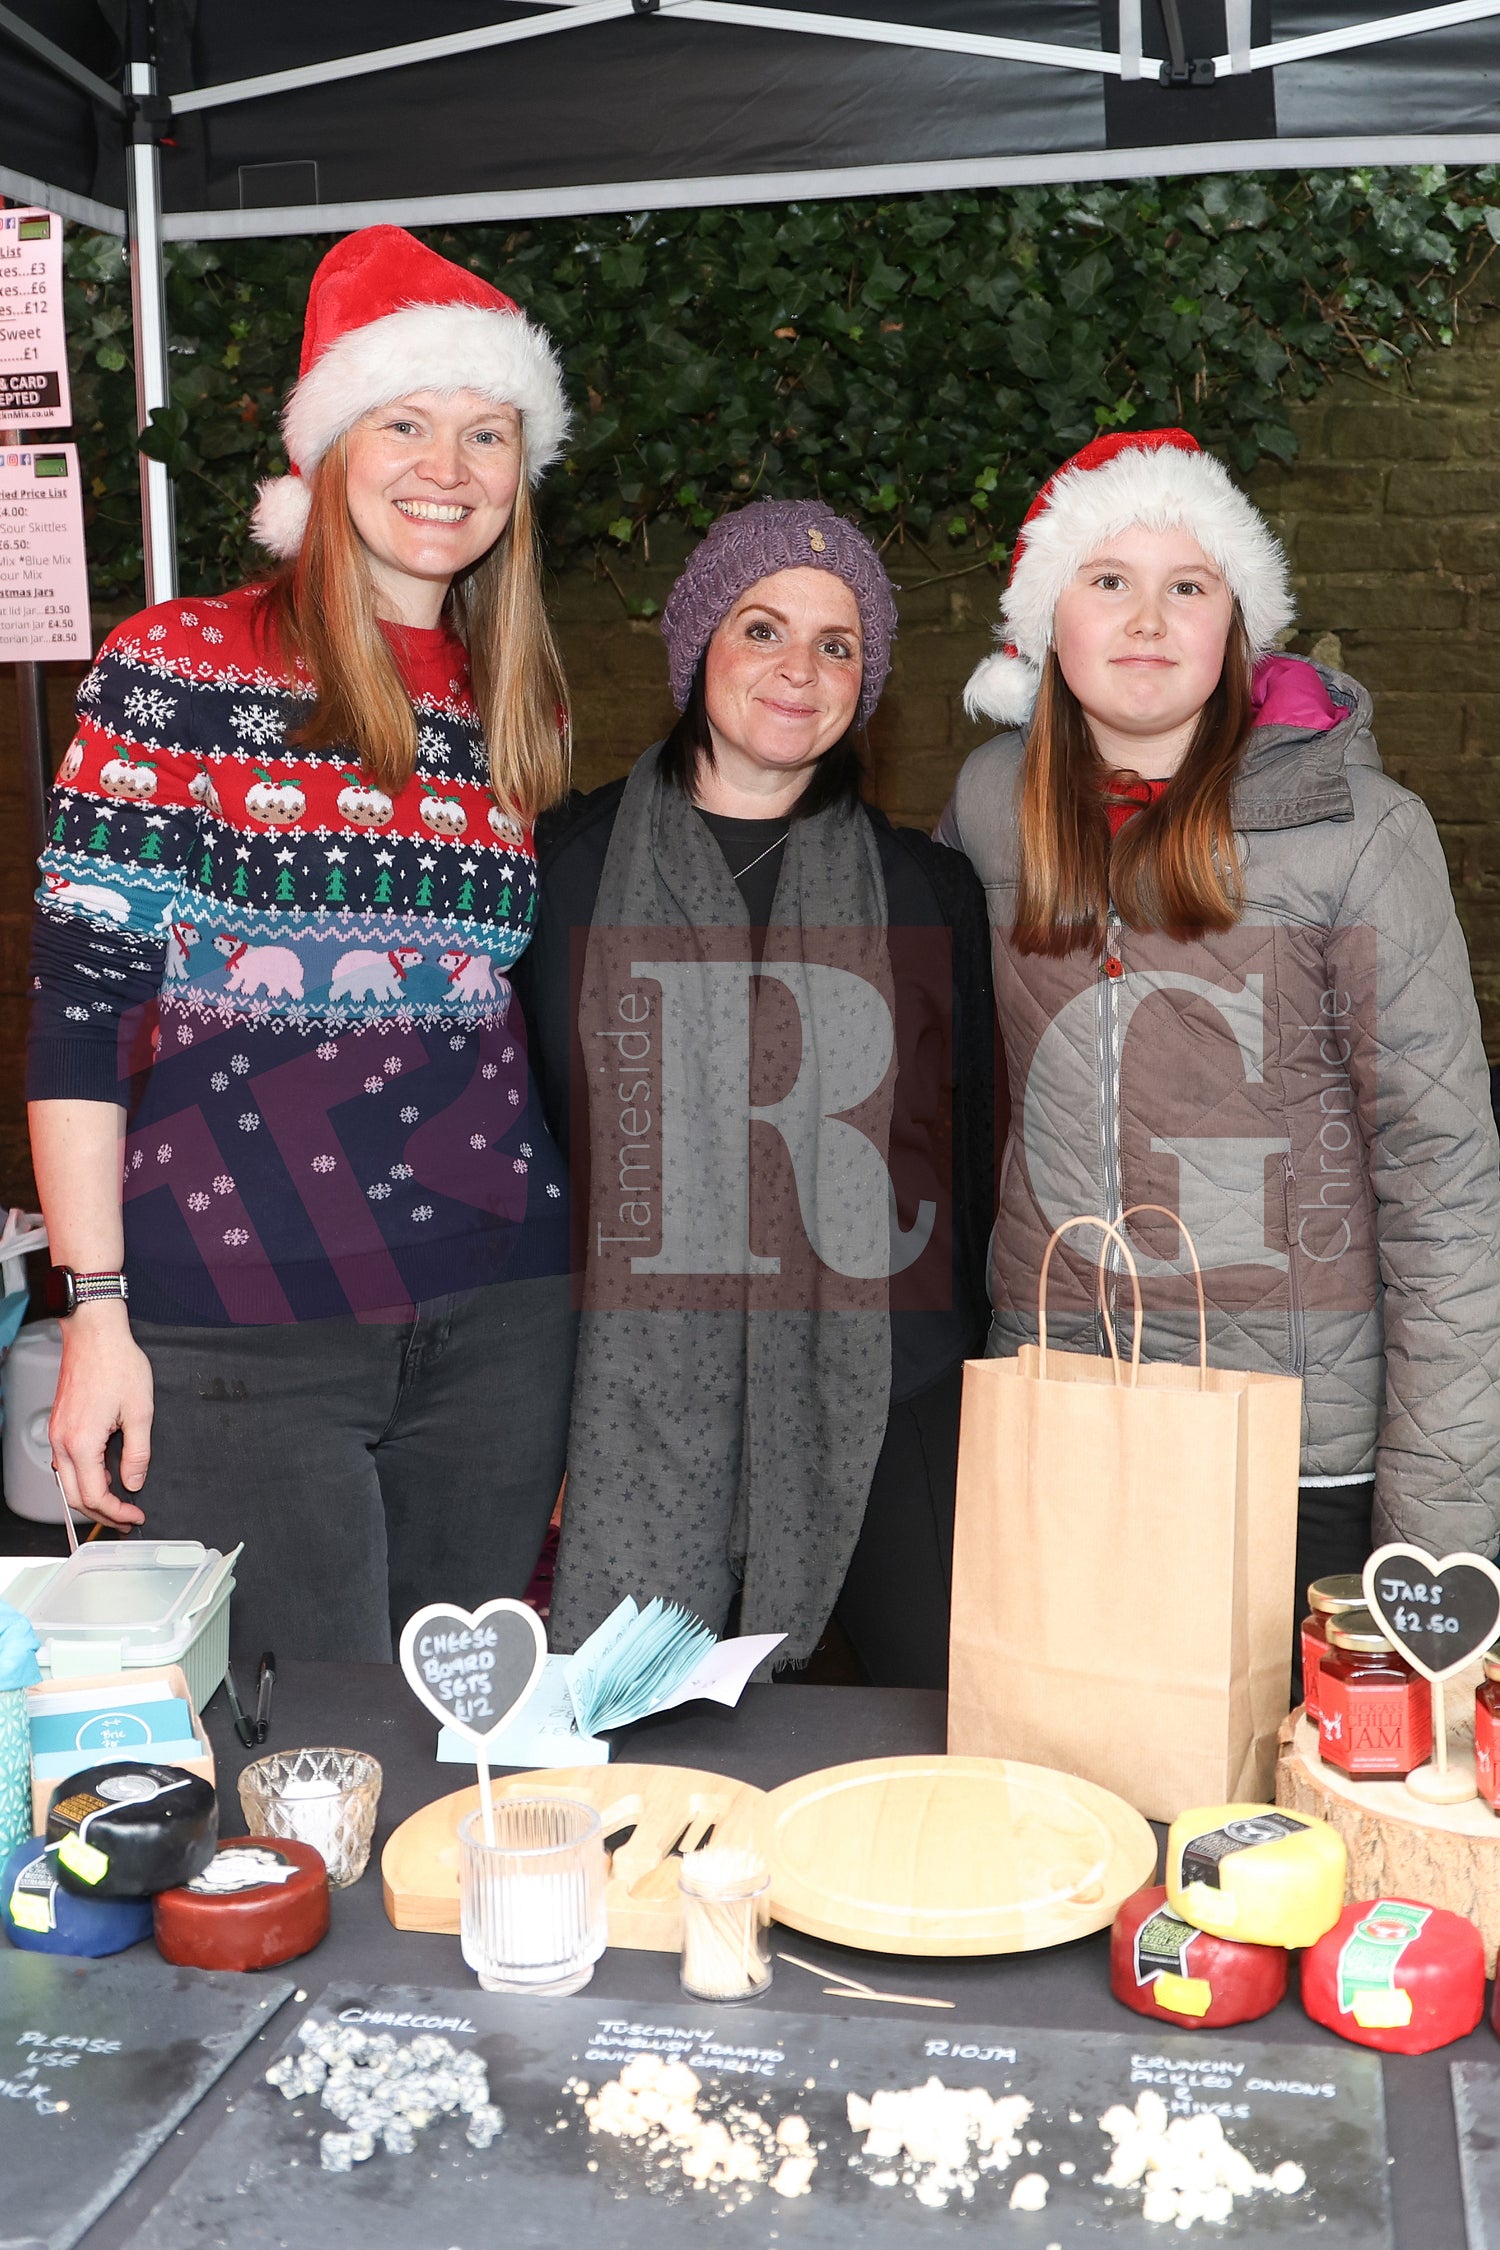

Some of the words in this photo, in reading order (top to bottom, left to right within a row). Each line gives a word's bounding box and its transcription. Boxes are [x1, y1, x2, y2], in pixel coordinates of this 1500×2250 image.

[0, 247, 21, 258] List
[0, 327, 41, 341] Sweet
[10, 375, 48, 391] CARD
[0, 408, 54, 420] knMix.co.uk
[0, 490, 17, 500] ied
[20, 489, 46, 499] Price
[48, 488, 67, 499] List
[0, 507, 28, 517] 4.00:
[0, 523, 26, 534] Sour
[29, 521, 67, 533] Skittles
[52, 554, 71, 565] Mix
[23, 570, 42, 580] Mix
[48, 619, 74, 629] £4.50
[1380, 1578, 1443, 1605] JARS
[1393, 1605, 1460, 1634] £2.50
[419, 1626, 498, 1657] CHEESE
[422, 1650, 496, 1683] BOARD
[438, 1673, 493, 1700] SETS
[454, 1697, 494, 1723] £12
[1346, 1714, 1404, 1727] CHILLI
[1345, 1727, 1403, 1753] JAM
[338, 2007, 477, 2033] CHARCOAL
[597, 2019, 715, 2042] TUSCANY
[16, 2031, 123, 2054] PLEASE
[699, 2042, 785, 2062] TOMATO
[924, 2039, 1017, 2064] RIOJA
[26, 2050, 82, 2067] USE
[688, 2054, 776, 2076] GARLIC
[1131, 2054, 1245, 2076] CRUNCHY
[14, 2066, 39, 2080] A
[1130, 2069, 1232, 2088] PICKLED
[1247, 2077, 1336, 2098] ONIONS
